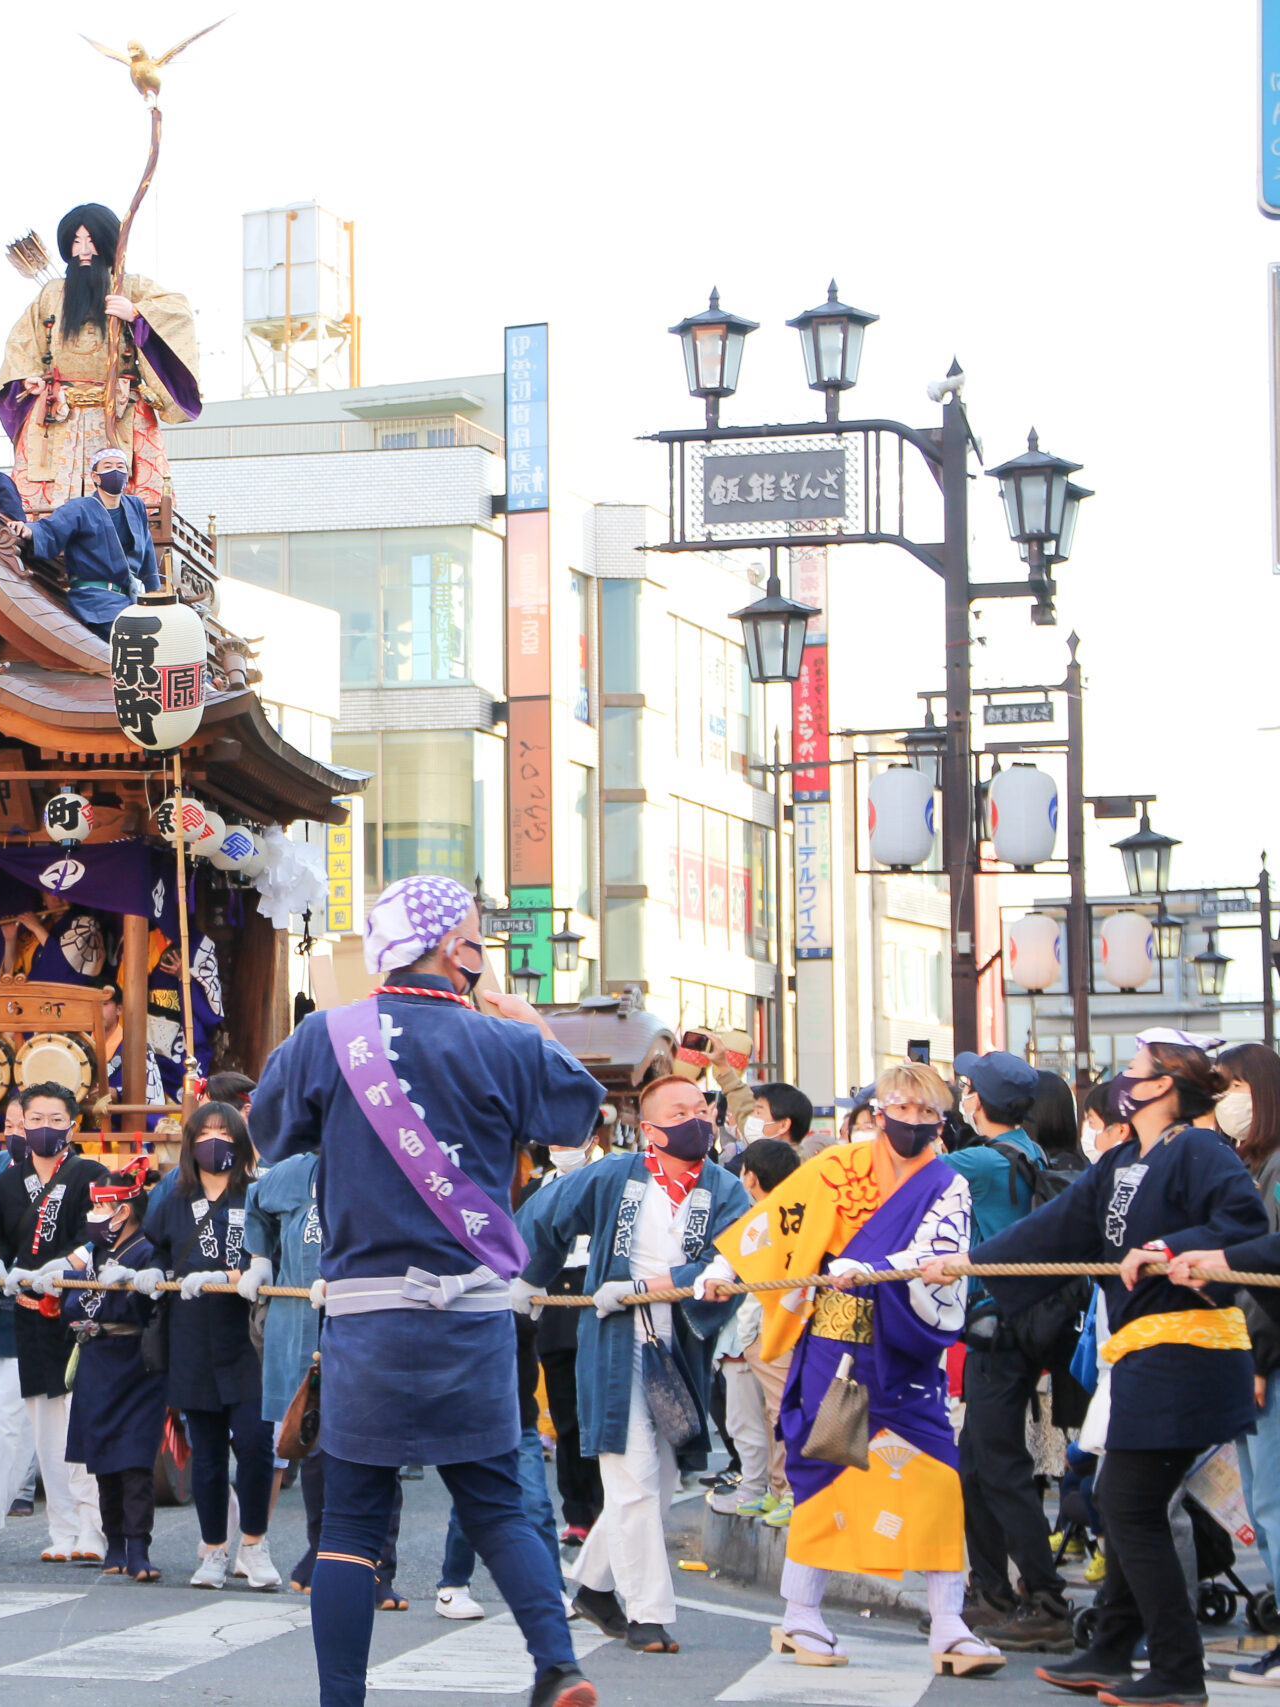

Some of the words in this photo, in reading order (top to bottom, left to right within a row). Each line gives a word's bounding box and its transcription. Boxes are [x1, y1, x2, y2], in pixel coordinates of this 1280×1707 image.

[708, 466, 844, 506] 飯能ぎんざ
[111, 616, 162, 746] 原町
[47, 797, 81, 831] 町
[798, 806, 818, 943] エーデルワイス
[39, 1199, 61, 1242] 原町
[682, 1208, 710, 1260] 原町
[1102, 1183, 1138, 1247] 原町
[226, 1225, 245, 1271] 原町
